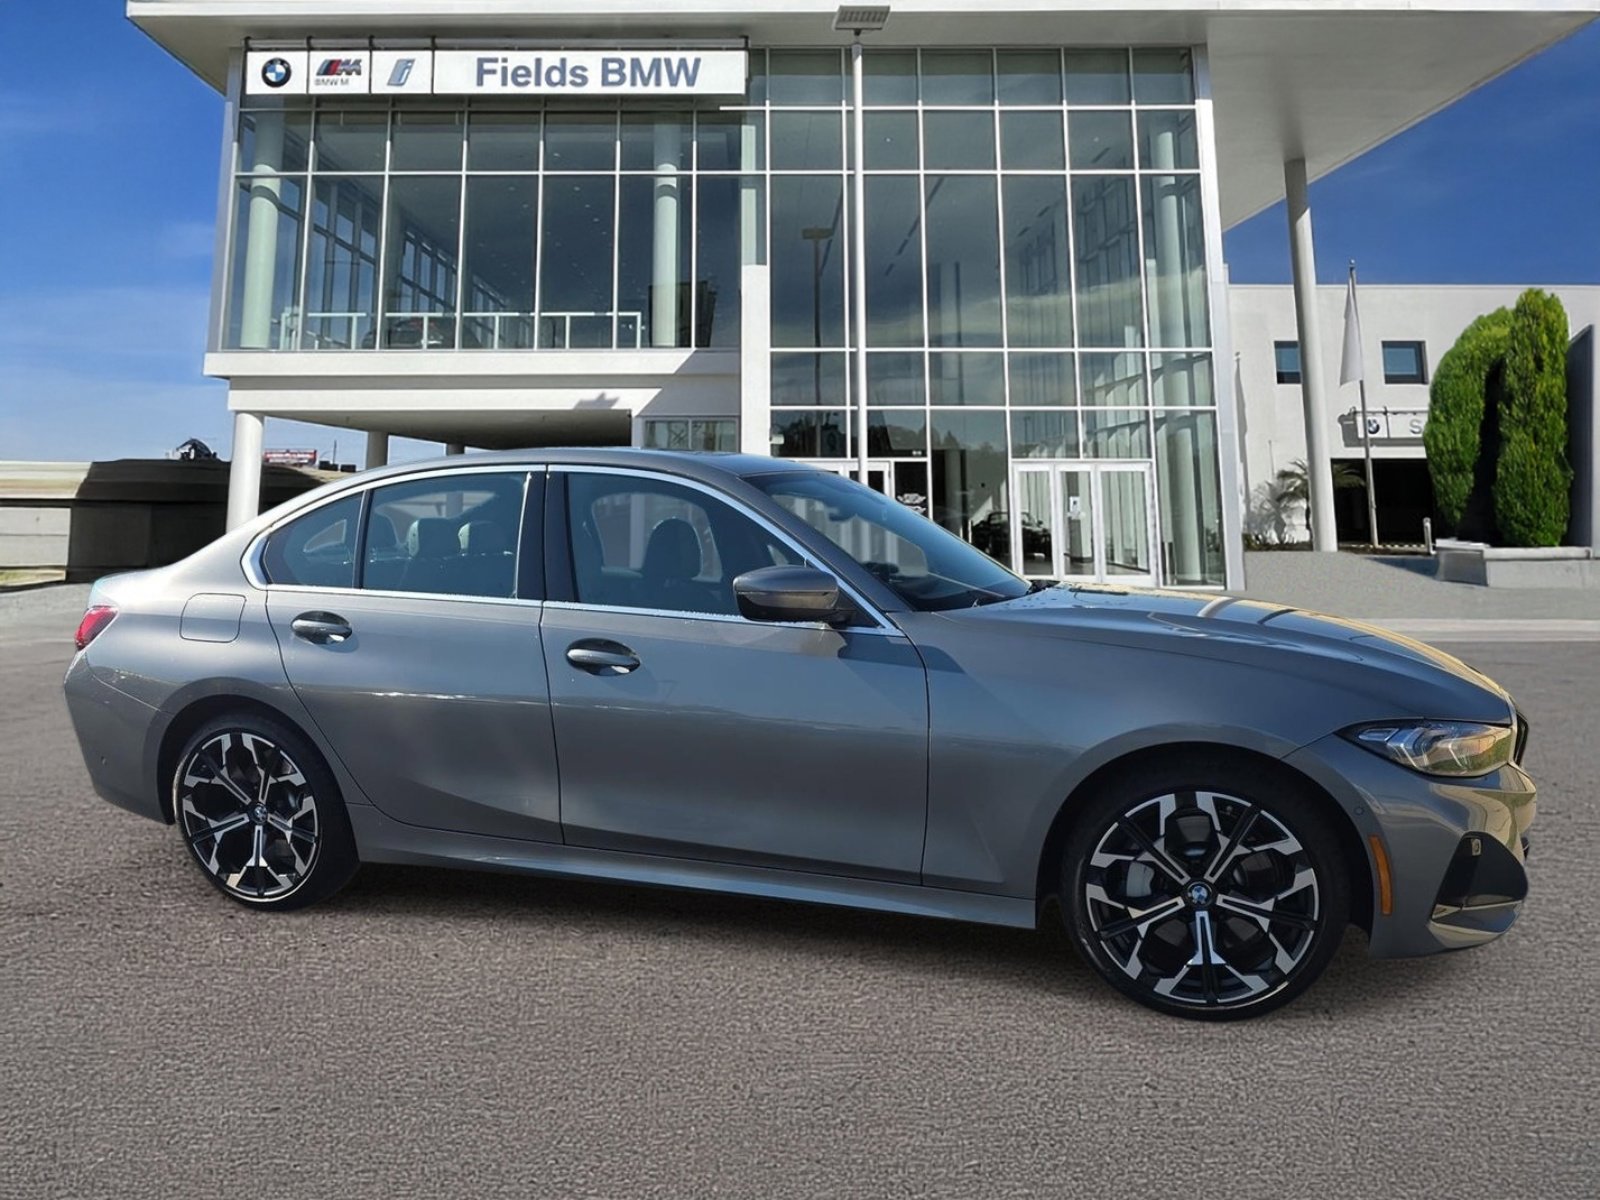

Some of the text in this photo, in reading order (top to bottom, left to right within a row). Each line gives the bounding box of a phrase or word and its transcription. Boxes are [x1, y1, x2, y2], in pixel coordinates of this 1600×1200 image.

[476, 57, 702, 87] Fields BMW
[314, 78, 338, 86] BMW
